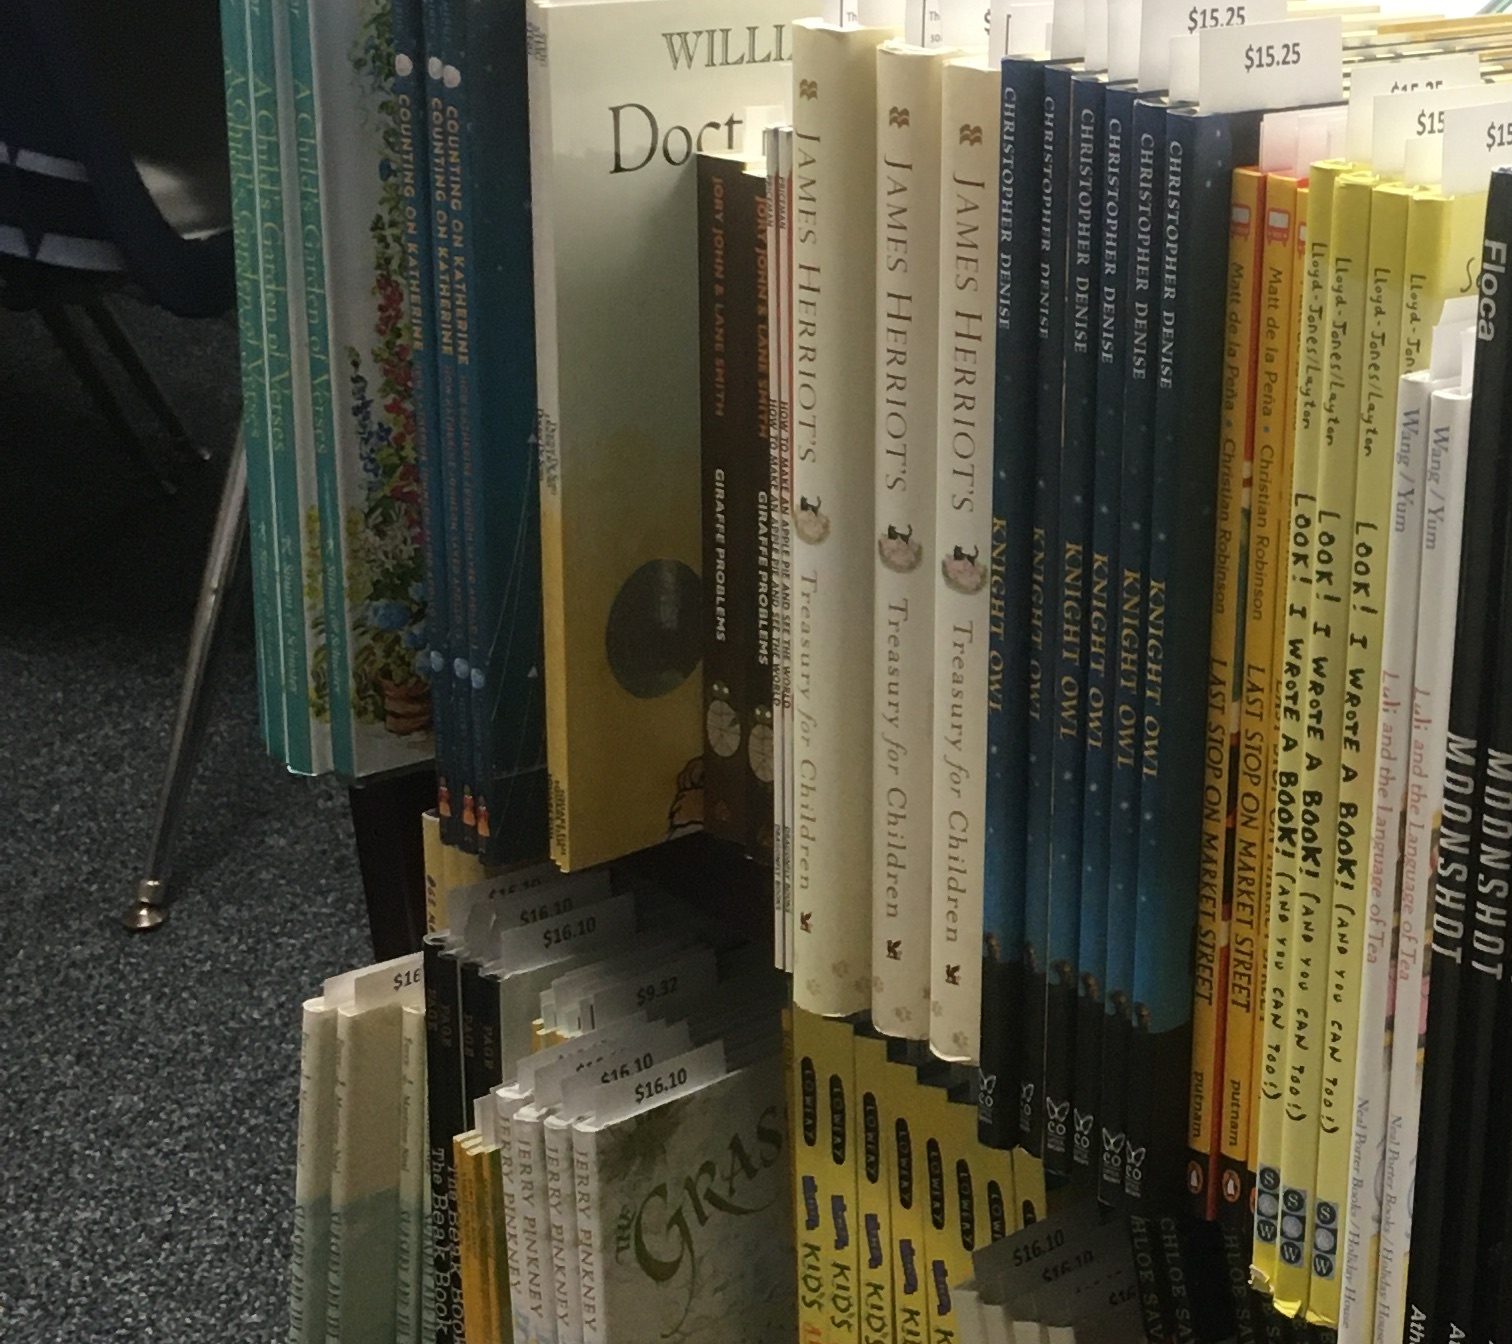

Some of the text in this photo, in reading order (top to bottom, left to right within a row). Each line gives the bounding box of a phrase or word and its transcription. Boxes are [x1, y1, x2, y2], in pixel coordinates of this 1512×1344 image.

[662, 24, 792, 71] WILLI
[1187, 6, 1246, 34] $15.25
[1244, 42, 1301, 72] $15.25
[609, 102, 743, 174] Doct
[399, 94, 424, 352] COUNTING ON KATHERINE
[998, 86, 1018, 331] CHRISTOPHER DENISE
[796, 130, 821, 463] JAMES HERRIOT'S
[1477, 238, 1507, 342] Floca
[714, 358, 726, 418] SMITH
[1251, 266, 1284, 623] Matt Peña Christian Robinson
[1425, 425, 1452, 551] Wang Yum
[714, 467, 726, 643] GIRAFFE PROBLEMS
[1350, 520, 1377, 616] LOOK!
[1141, 580, 1166, 779] KNIGHT OWL
[1341, 668, 1365, 753] WROTE
[943, 619, 975, 943] Treasury Children
[1231, 737, 1264, 1013] STOP MARKET STREET
[1335, 801, 1359, 890] BOOK!
[1430, 729, 1477, 965] MOONSHOT
[1397, 808, 1425, 982] Language Tea
[634, 974, 680, 1006] $9.32
[633, 1068, 689, 1104] $16.10
[1328, 1020, 1343, 1063] CAN
[1228, 1079, 1242, 1147] putnam
[1011, 1228, 1066, 1269] $16.10
